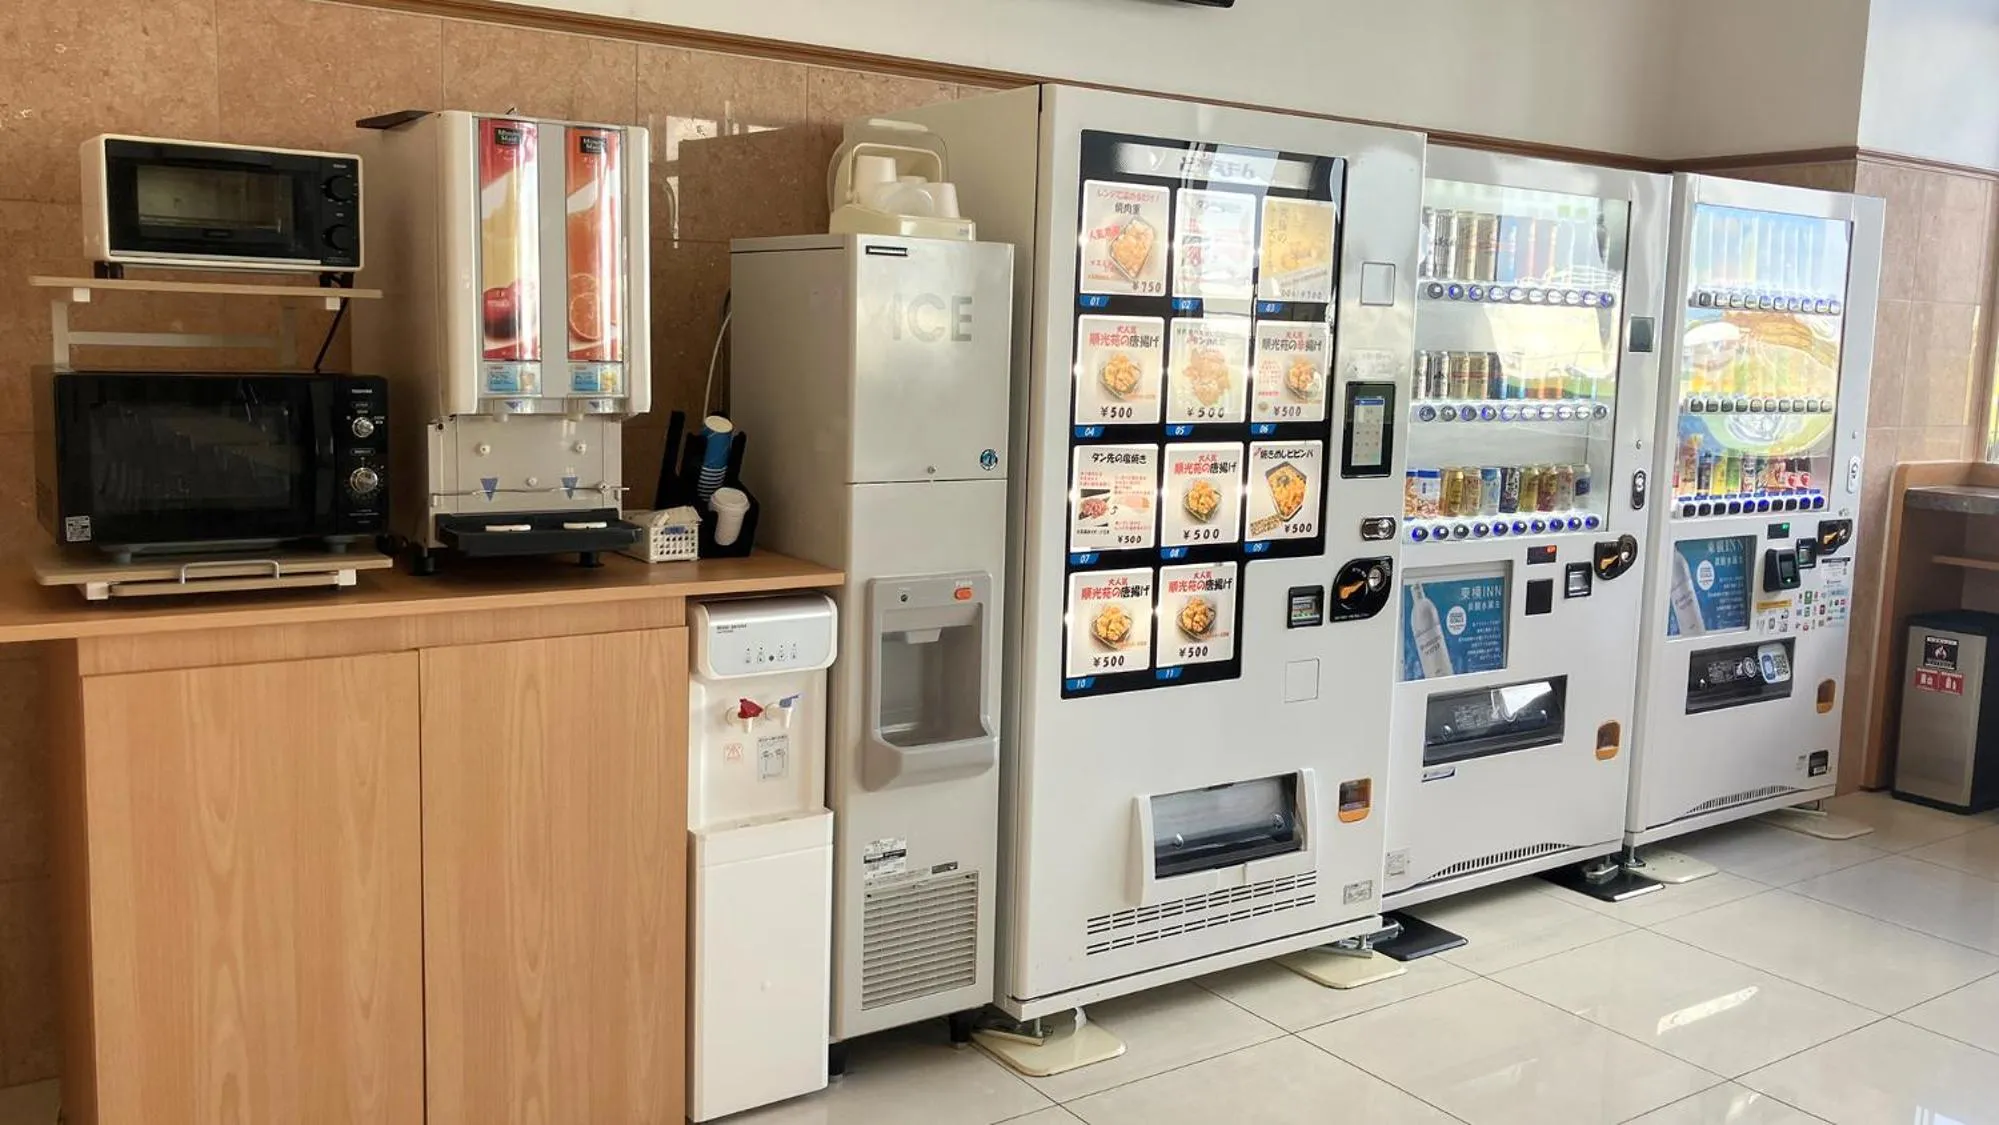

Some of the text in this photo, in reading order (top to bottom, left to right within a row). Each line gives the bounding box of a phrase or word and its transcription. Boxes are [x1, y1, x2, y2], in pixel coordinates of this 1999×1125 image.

[1089, 296, 1100, 306] 01
[892, 293, 973, 342] ICE
[1101, 406, 1133, 418] ¥500
[1187, 407, 1226, 418] ¥500
[1273, 406, 1302, 417] ¥500
[1084, 427, 1095, 437] 04
[1175, 425, 1186, 436] 05
[1284, 523, 1313, 533] ¥500
[1117, 535, 1142, 544] ¥500
[1183, 528, 1220, 540] ¥500
[1080, 554, 1090, 564] 07
[1179, 646, 1209, 658] ¥500
[1093, 655, 1125, 667] ¥500
[1165, 668, 1174, 678] 11
[1076, 679, 1086, 688] 10
